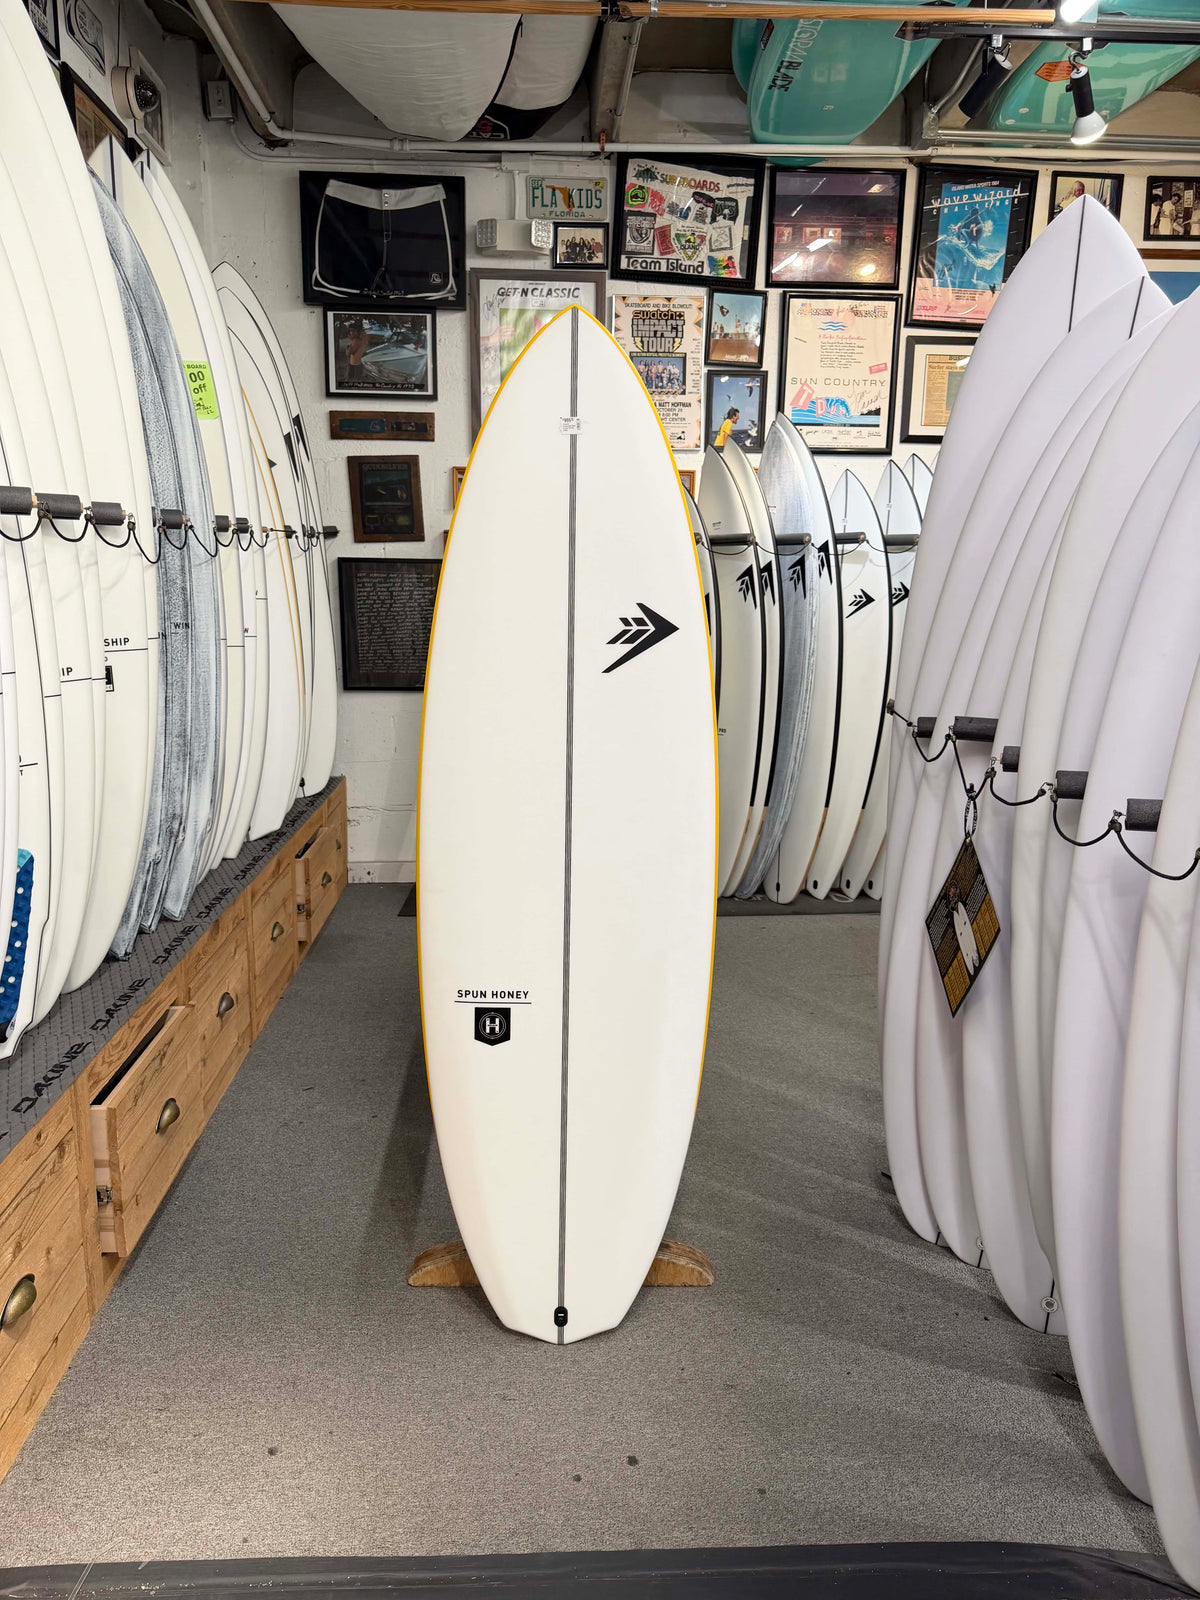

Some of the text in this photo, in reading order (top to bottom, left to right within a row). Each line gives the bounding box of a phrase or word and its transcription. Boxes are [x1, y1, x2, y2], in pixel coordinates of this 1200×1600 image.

[532, 187, 603, 209] FLA KIDS
[549, 210, 585, 218] FLORIDA
[625, 256, 704, 274] Team Island
[531, 287, 580, 299] CLASSIC
[632, 309, 676, 320] swatch
[632, 319, 685, 338] IMPACT
[642, 337, 674, 352] TOUR
[790, 377, 887, 387] SUN COUNTRY
[192, 383, 207, 394] off
[173, 622, 190, 630] WIN
[103, 637, 130, 647] SHIP
[152, 925, 199, 964] DAKINE
[457, 989, 529, 999] SPUN HONEY
[90, 978, 150, 1030] DAKINE
[11, 1041, 92, 1113] DAKINE
